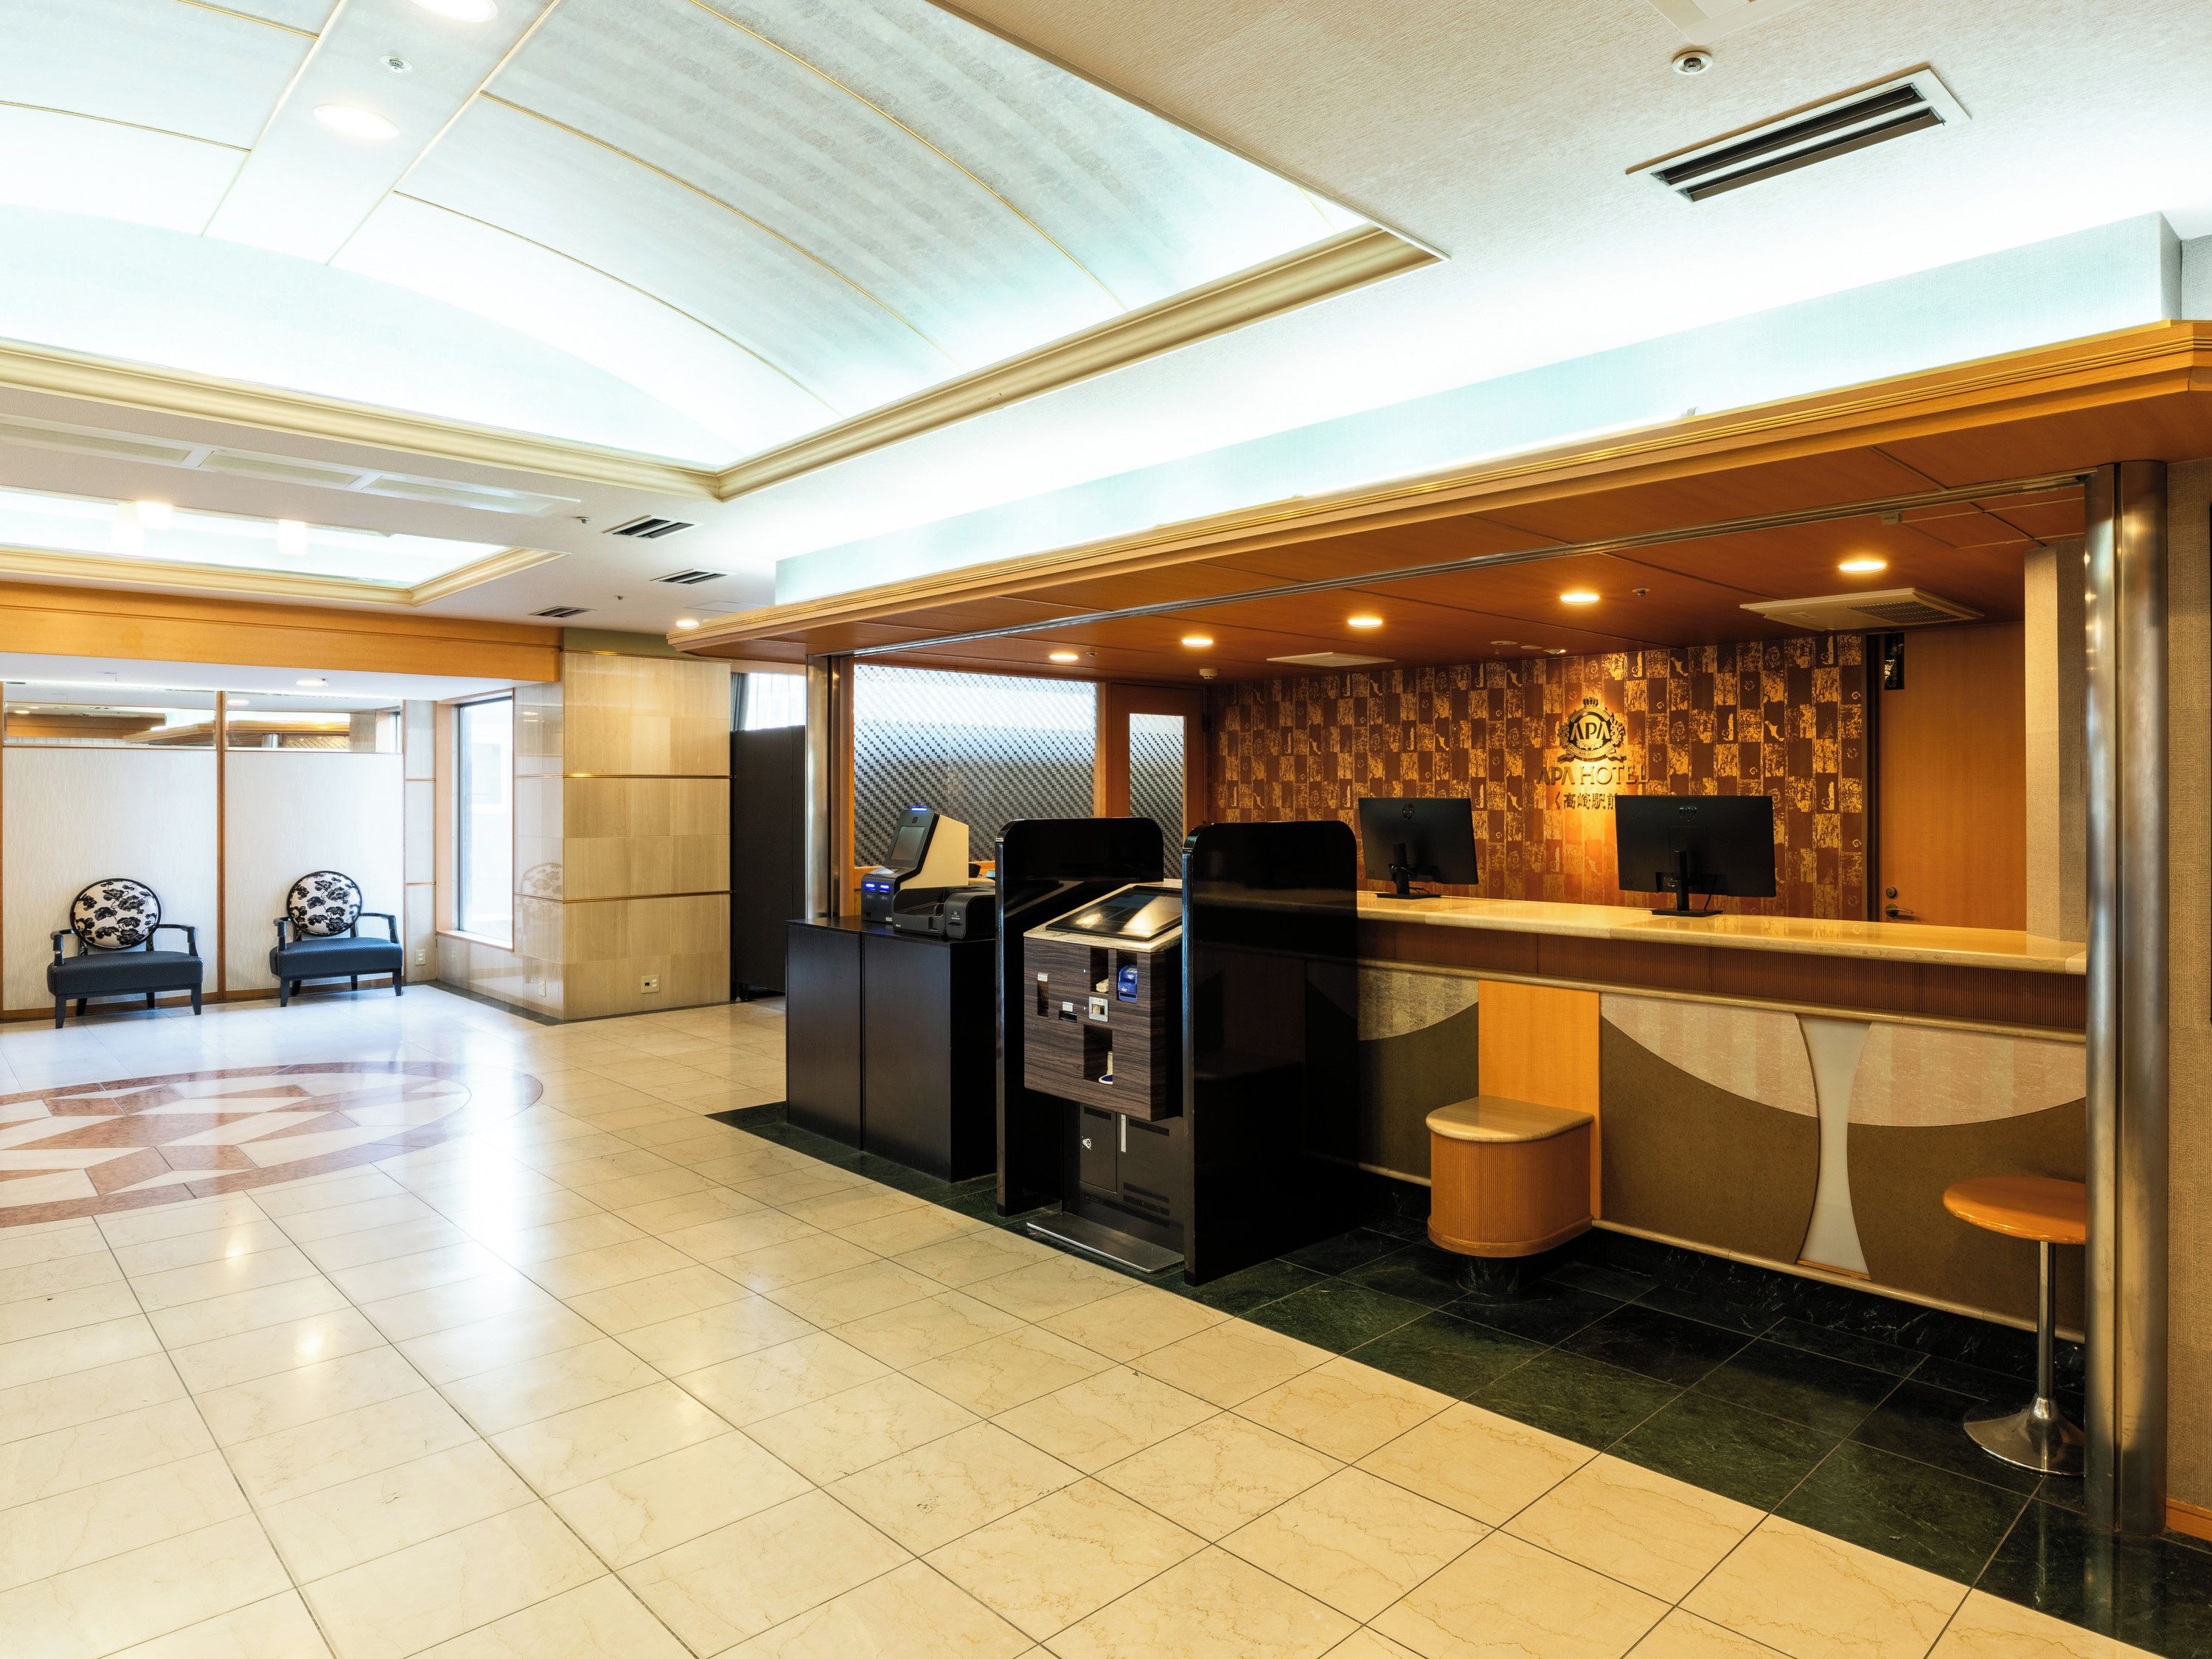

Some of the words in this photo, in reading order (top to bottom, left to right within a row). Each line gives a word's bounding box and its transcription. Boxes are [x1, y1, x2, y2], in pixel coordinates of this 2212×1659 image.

[1570, 722, 1610, 740] APA
[1537, 766, 1575, 785] APA
[1580, 765, 1649, 785] HOTEL
[1554, 791, 1627, 810] 〈高崎駅前
